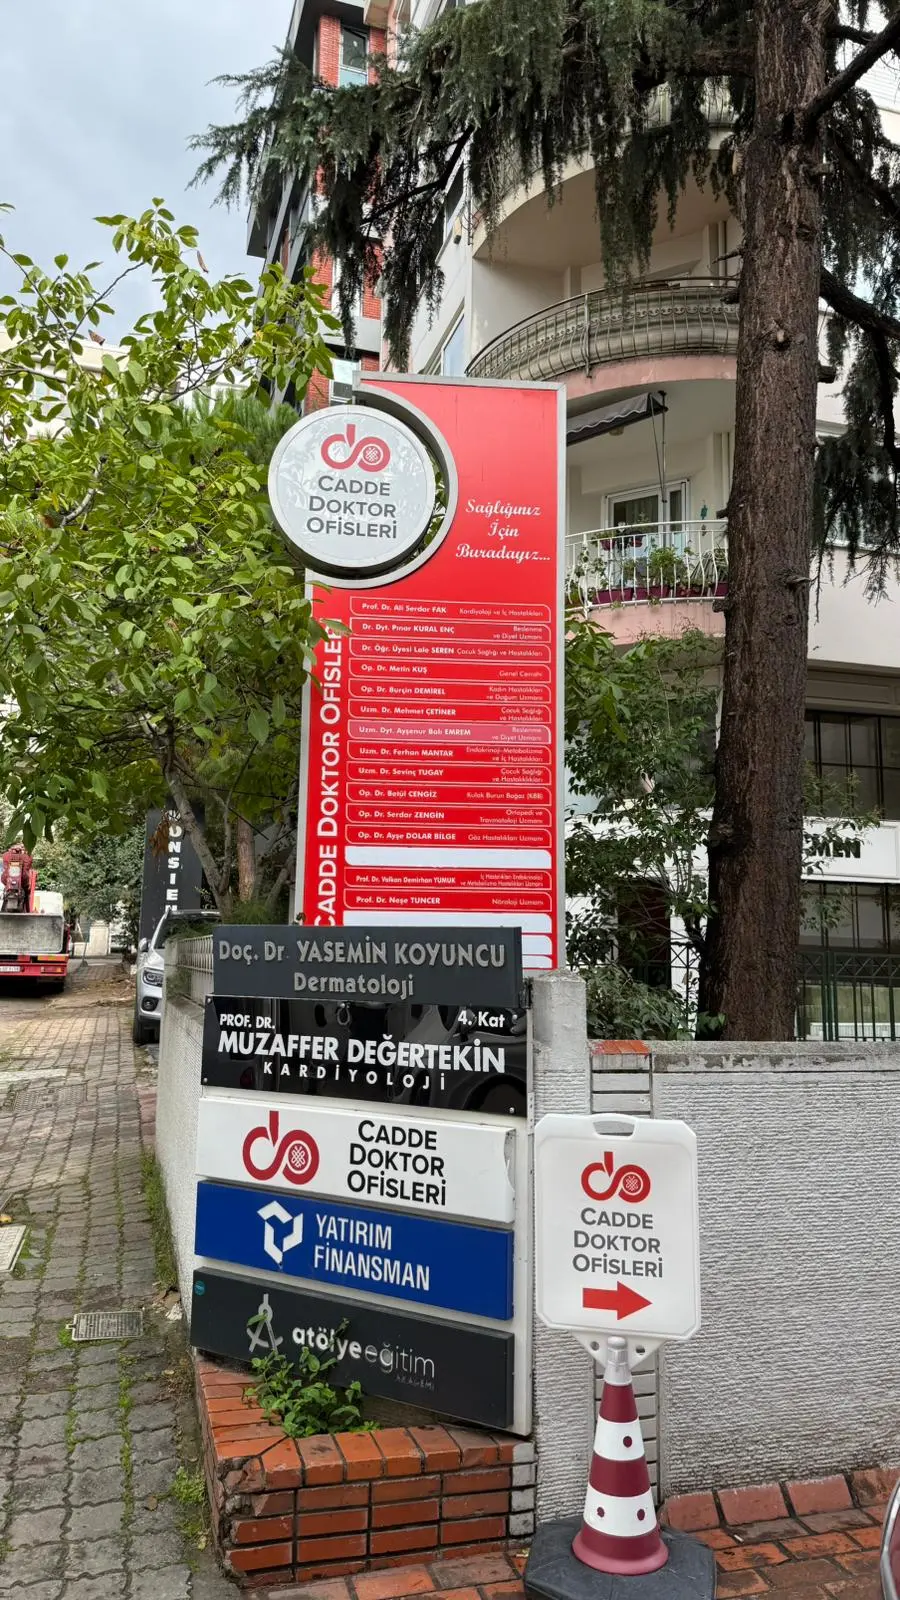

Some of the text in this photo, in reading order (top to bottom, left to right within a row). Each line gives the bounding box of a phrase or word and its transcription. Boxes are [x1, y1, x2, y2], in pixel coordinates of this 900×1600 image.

[318, 475, 391, 496] CADDE
[309, 495, 397, 519] DOKTOR
[465, 498, 542, 518] Sağlığınız
[306, 517, 397, 539] OFİSLERİ
[487, 519, 520, 540] İçin
[440, 626, 454, 634] ENÇ
[374, 645, 390, 653] Öğr.
[392, 644, 412, 653] Üyesi
[412, 666, 428, 674] KUŞ
[426, 707, 456, 716] ÇETİNER
[380, 727, 395, 735] Dyt.
[393, 768, 416, 776] Sevinç
[316, 731, 340, 837] DOKTOR
[408, 789, 437, 797] CENGİZ
[386, 832, 404, 840] Ayşe
[434, 832, 456, 840] BİLGE
[314, 844, 337, 927] CADDE
[389, 897, 408, 905] Neşe
[219, 935, 506, 967] Doç. Dr. YASEMİN KOYUNCU
[294, 971, 415, 1000] Dermatoloji
[219, 1013, 276, 1029] PROF. DR.
[457, 1011, 506, 1028] 4. Kat
[217, 1030, 506, 1074] MUZAFFER DEĞERTEKİN
[263, 1061, 445, 1091] KARDİYOLOJİ
[357, 1119, 438, 1151] CADDE
[349, 1143, 445, 1177] DOKTOR
[346, 1170, 447, 1206] OFİSLERİ
[580, 1207, 654, 1230] CADDE
[315, 1213, 393, 1251] YATIRIM
[573, 1230, 661, 1254] DOKTOR
[313, 1242, 431, 1291] FİNANSMAN
[572, 1252, 663, 1278] OFİSLERİ
